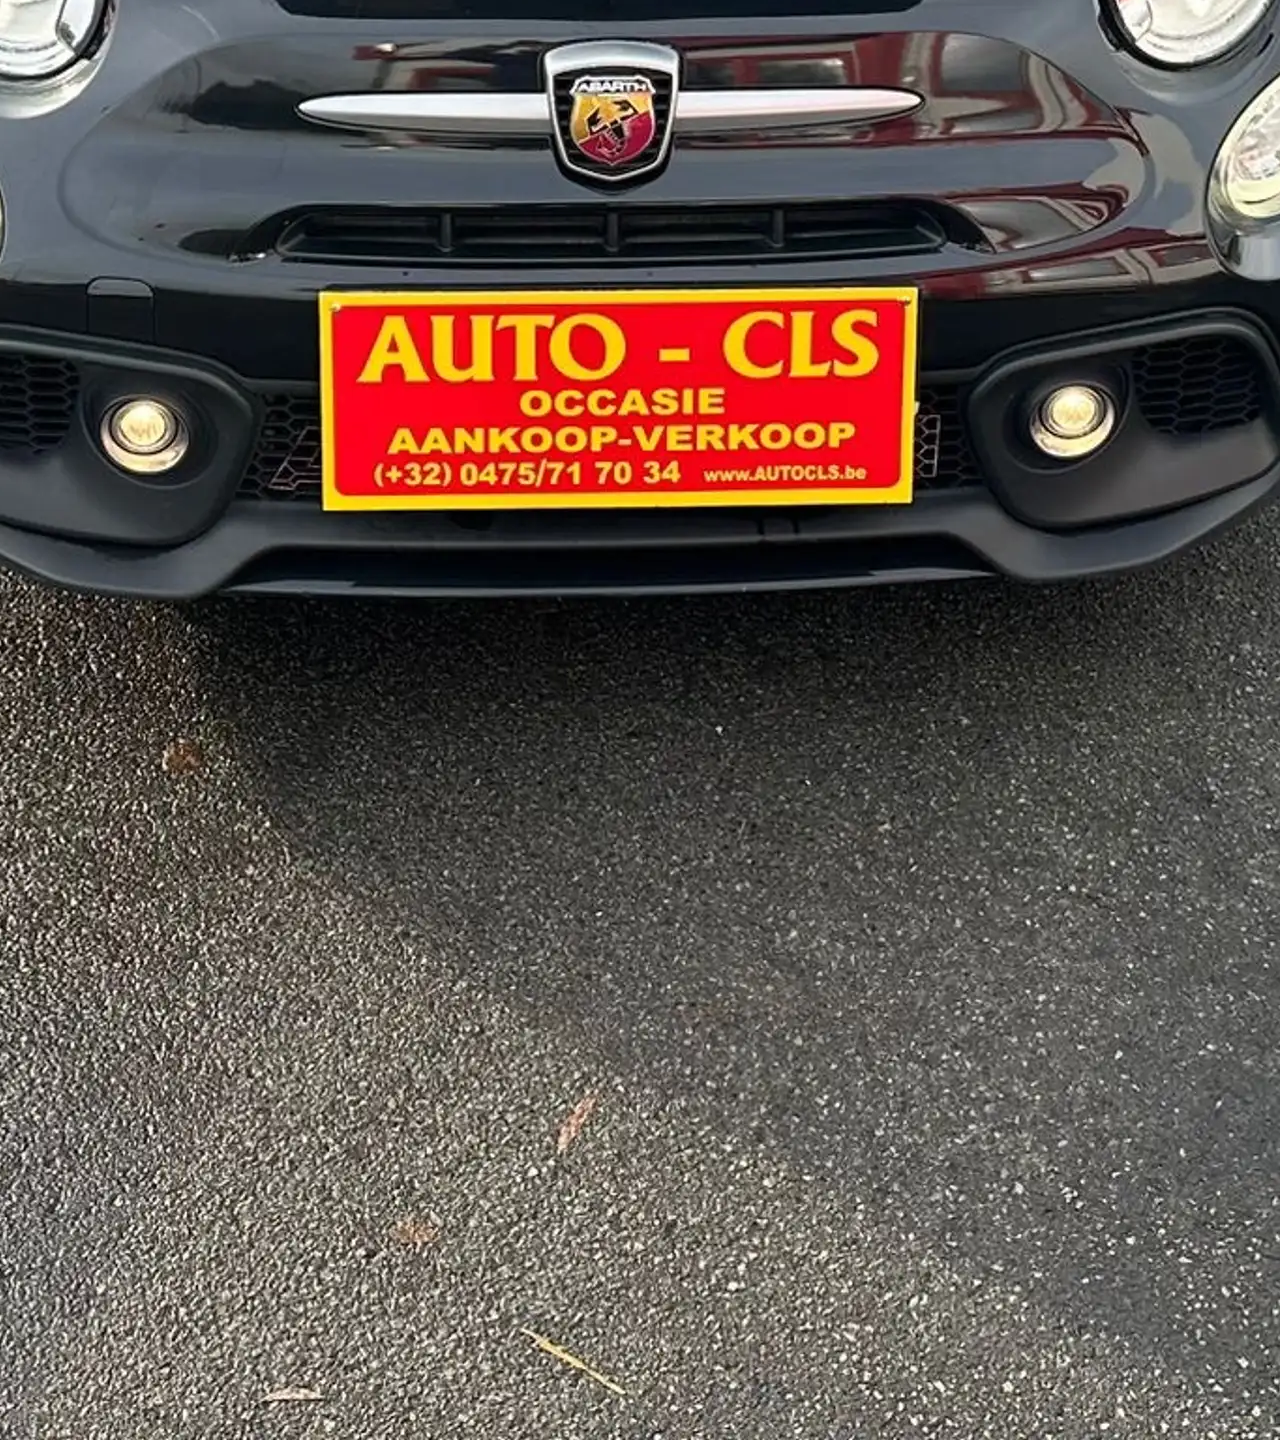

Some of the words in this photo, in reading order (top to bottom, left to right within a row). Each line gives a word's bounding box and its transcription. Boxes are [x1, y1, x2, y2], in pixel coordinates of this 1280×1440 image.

[578, 79, 647, 93] ABARTH
[356, 313, 627, 383] AUTO
[723, 310, 880, 379] CLS
[519, 388, 726, 417] OCCASIE
[387, 422, 857, 454] AANKOOP-VERKOOP
[373, 462, 452, 487] (+32)
[460, 461, 582, 486] 0475/71
[595, 461, 632, 485] 70
[643, 460, 682, 484] 34
[703, 464, 867, 482] www.AUTOCLS.be
